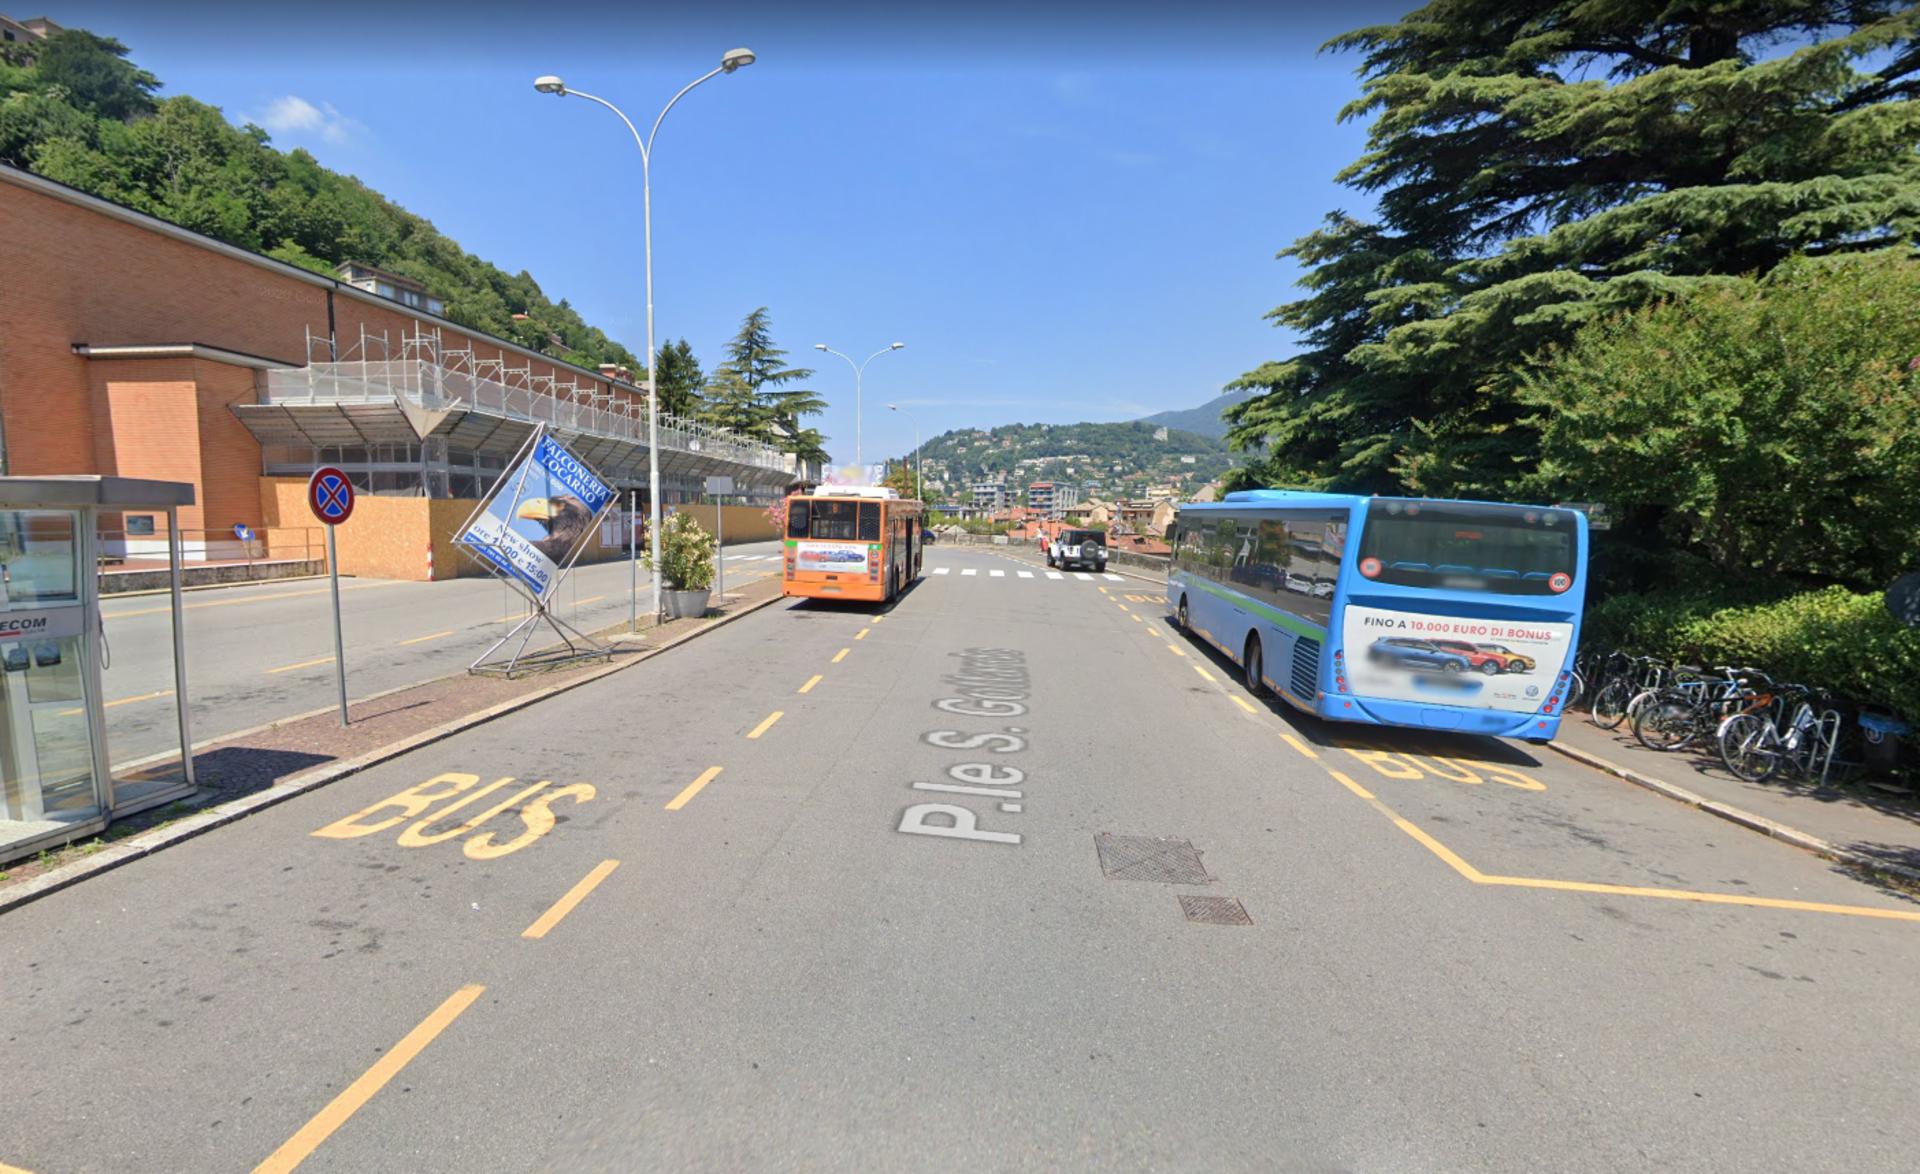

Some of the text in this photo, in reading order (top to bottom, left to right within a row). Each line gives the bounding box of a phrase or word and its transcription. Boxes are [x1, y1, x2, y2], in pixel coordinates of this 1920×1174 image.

[542, 454, 596, 503] LOCARNO
[543, 439, 606, 500] FALCONERIA
[473, 525, 490, 539] ore
[525, 562, 548, 582] 15:00
[496, 524, 544, 564] New show
[1364, 617, 1552, 640] FINO A 10.000 EURO DI BONUS
[309, 772, 597, 860] BUS
